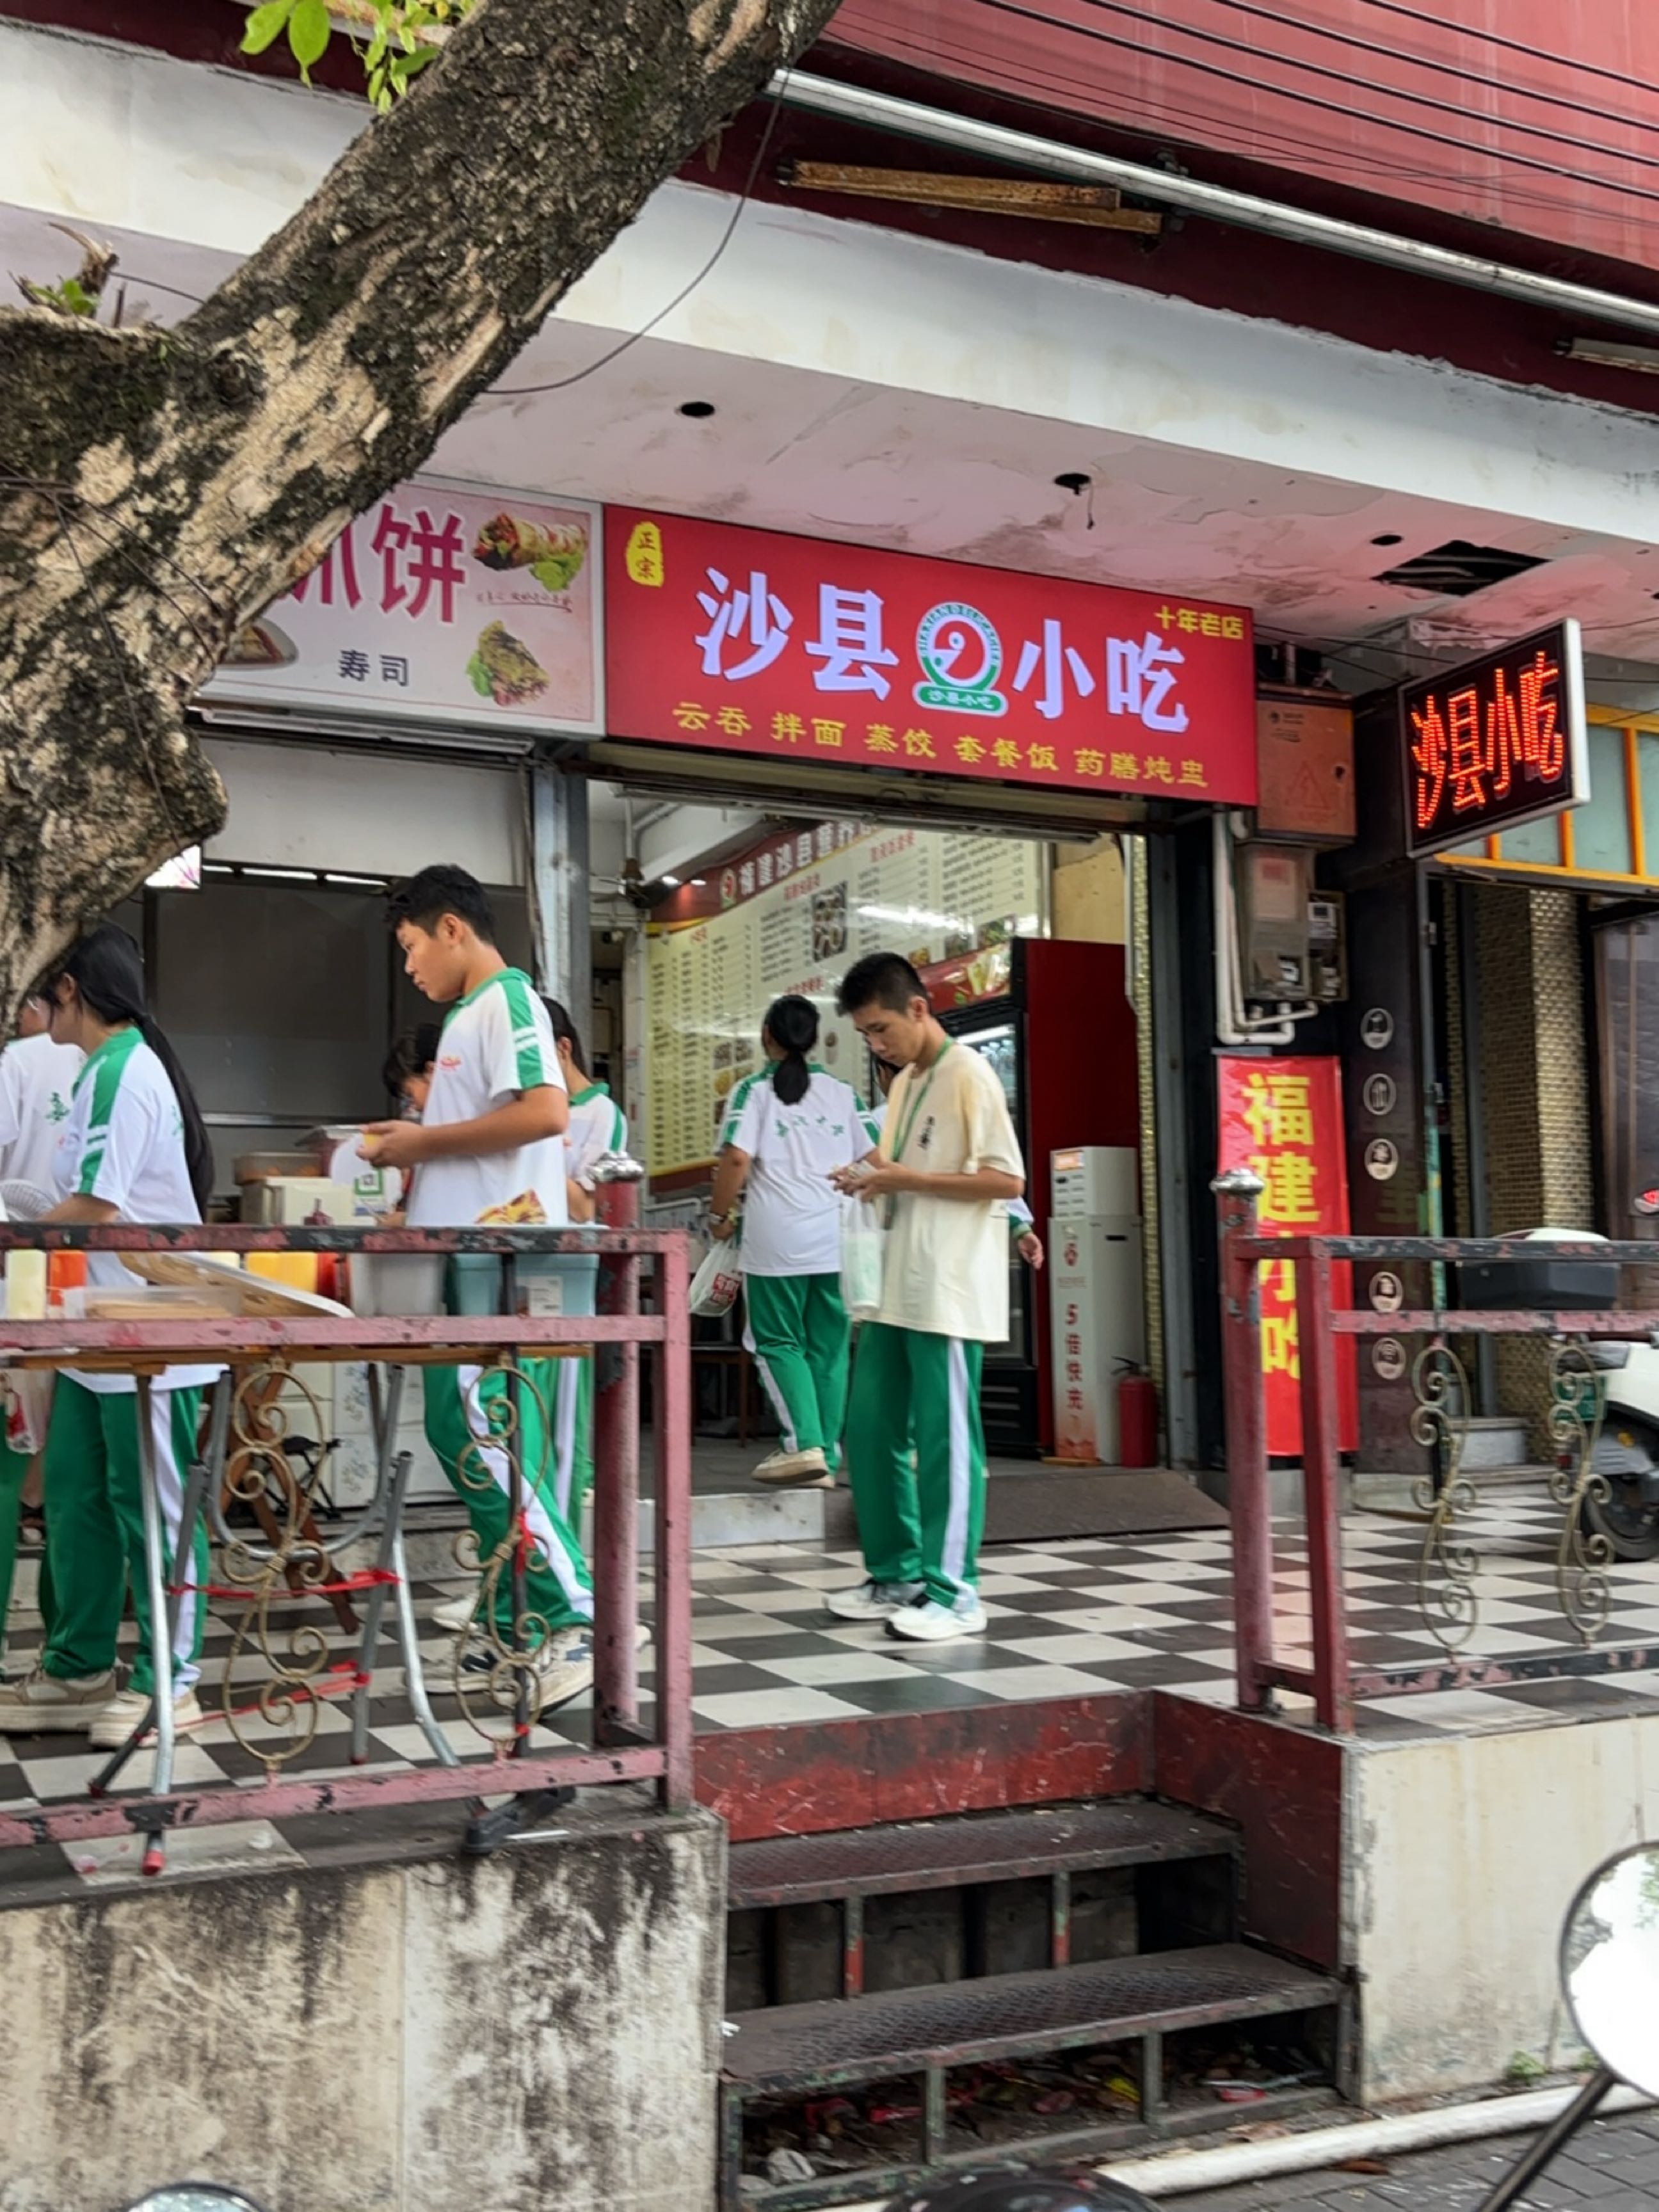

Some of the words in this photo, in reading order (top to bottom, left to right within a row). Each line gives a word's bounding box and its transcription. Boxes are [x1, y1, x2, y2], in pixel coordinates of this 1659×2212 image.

[636, 531, 656, 579] 正宗
[694, 566, 900, 701] 沙县
[1012, 618, 1189, 733] 小吃
[1154, 605, 1243, 639] 十年老店
[339, 649, 409, 687] 寿司
[673, 701, 751, 736] 云吞
[771, 712, 846, 748] 拌面
[864, 723, 937, 758] 蒸饺
[953, 735, 1059, 771] 套餐饭
[1073, 748, 1208, 788] 药膳炖盅
[1411, 650, 1564, 828] 沙县小吃
